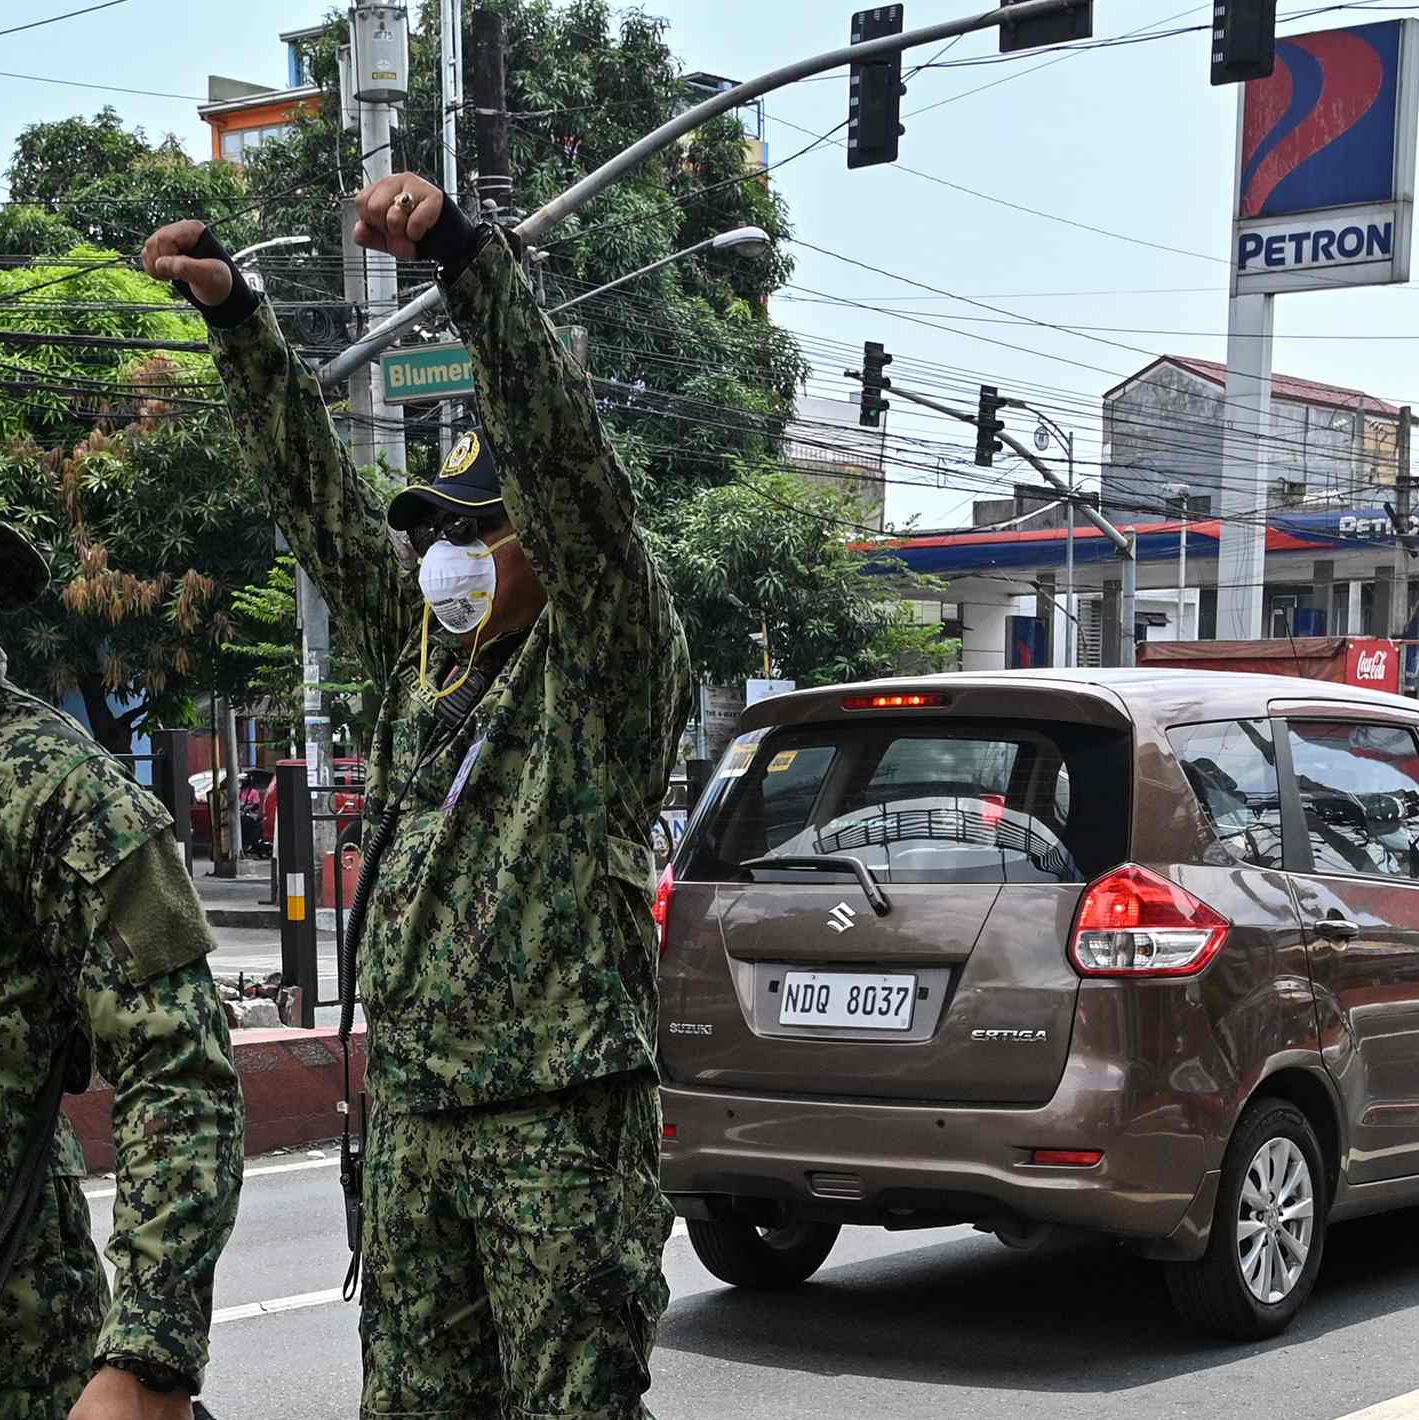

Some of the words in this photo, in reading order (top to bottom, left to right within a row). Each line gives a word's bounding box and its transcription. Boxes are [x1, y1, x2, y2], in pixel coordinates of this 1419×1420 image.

[1238, 222, 1392, 270] PETRON
[785, 984, 830, 1014] NDQ
[847, 985, 910, 1016] 8037
[669, 1023, 712, 1035] SUZUKI
